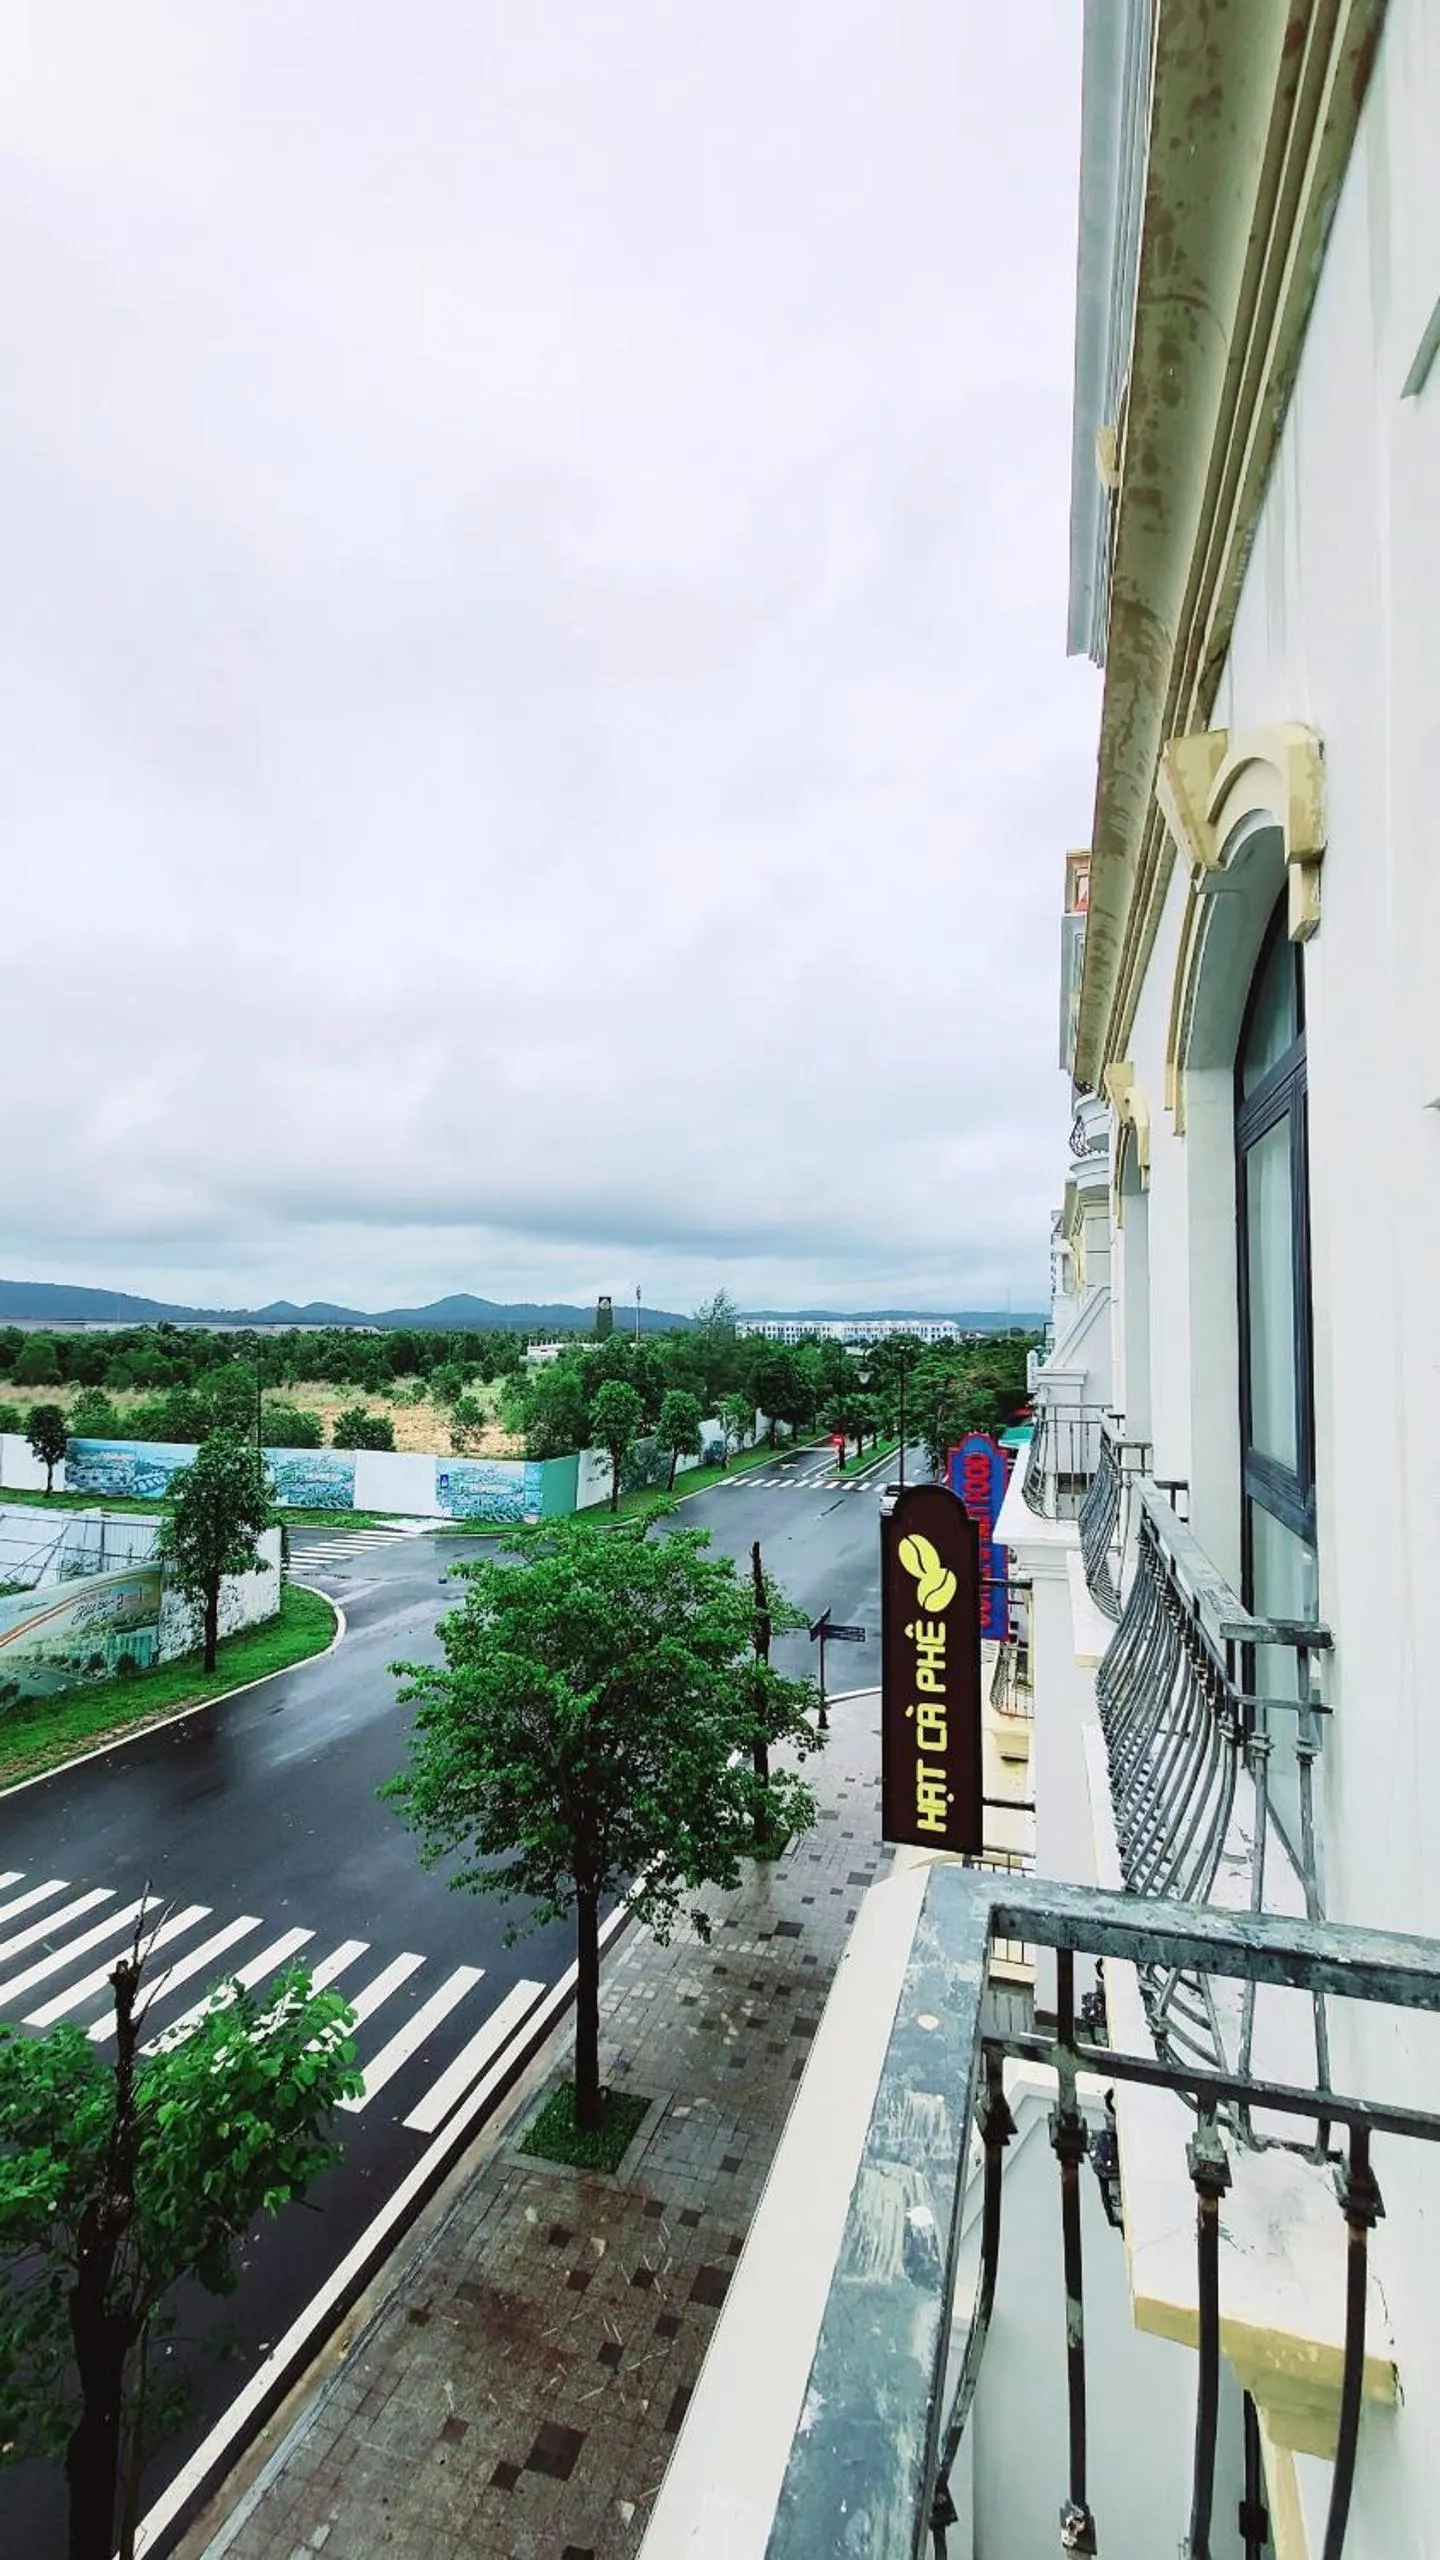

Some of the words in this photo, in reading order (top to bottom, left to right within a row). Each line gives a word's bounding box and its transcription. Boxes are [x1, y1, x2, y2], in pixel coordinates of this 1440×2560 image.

[903, 1619, 947, 1694] PHÊ
[904, 1703, 948, 1753] CÀ
[916, 1758, 955, 1833] HẠT
